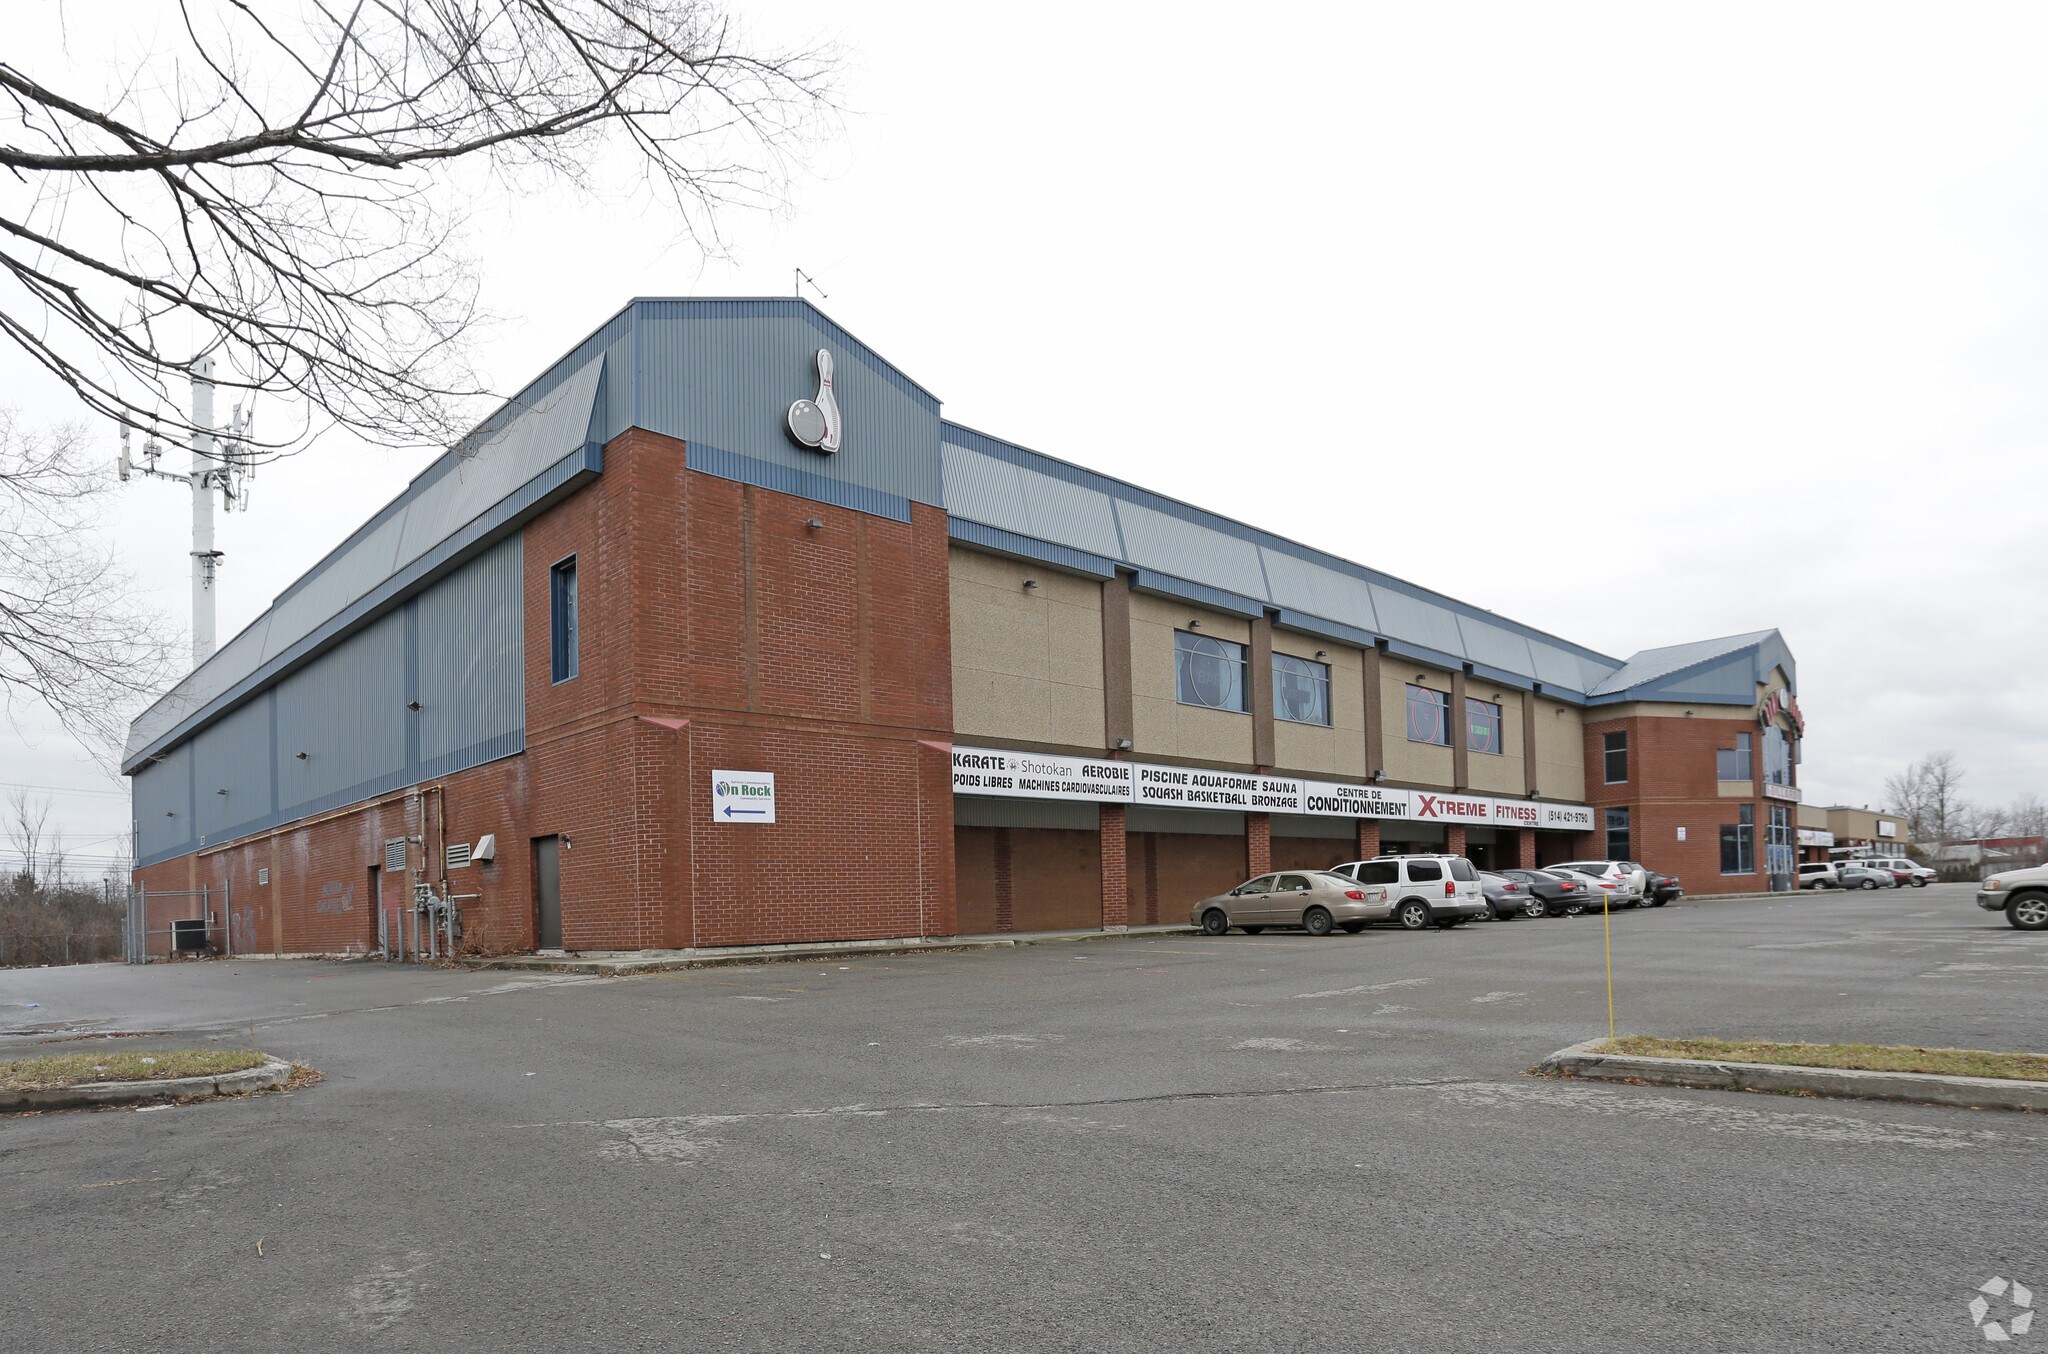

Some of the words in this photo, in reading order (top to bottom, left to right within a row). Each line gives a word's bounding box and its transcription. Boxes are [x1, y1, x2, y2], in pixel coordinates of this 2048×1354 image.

[953, 753, 1005, 770] KARATE
[1021, 760, 1072, 777] Shotokan
[1082, 765, 1129, 780] AEROBIE
[742, 785, 771, 796] Rock
[953, 774, 981, 787] POIDS
[983, 776, 1013, 789] LIBRES
[1019, 779, 1060, 792] MACHINES
[1061, 782, 1130, 796] CARDIOVASCULAIRES
[1141, 769, 1188, 785] PISCINE
[1192, 775, 1257, 791] AQUAFORME
[1262, 781, 1297, 794] SAUNA
[1142, 786, 1183, 800] SQUASH
[1187, 790, 1247, 805] BASKETBALL
[1252, 795, 1298, 808] BRONZAGE
[1337, 787, 1368, 799] CENTRE
[1371, 790, 1382, 800] DE
[1307, 795, 1407, 816] CONDITIONNEMENT
[1418, 795, 1487, 817] XTREME
[1496, 805, 1537, 820] FITNESS
[1548, 810, 1562, 822] (514)
